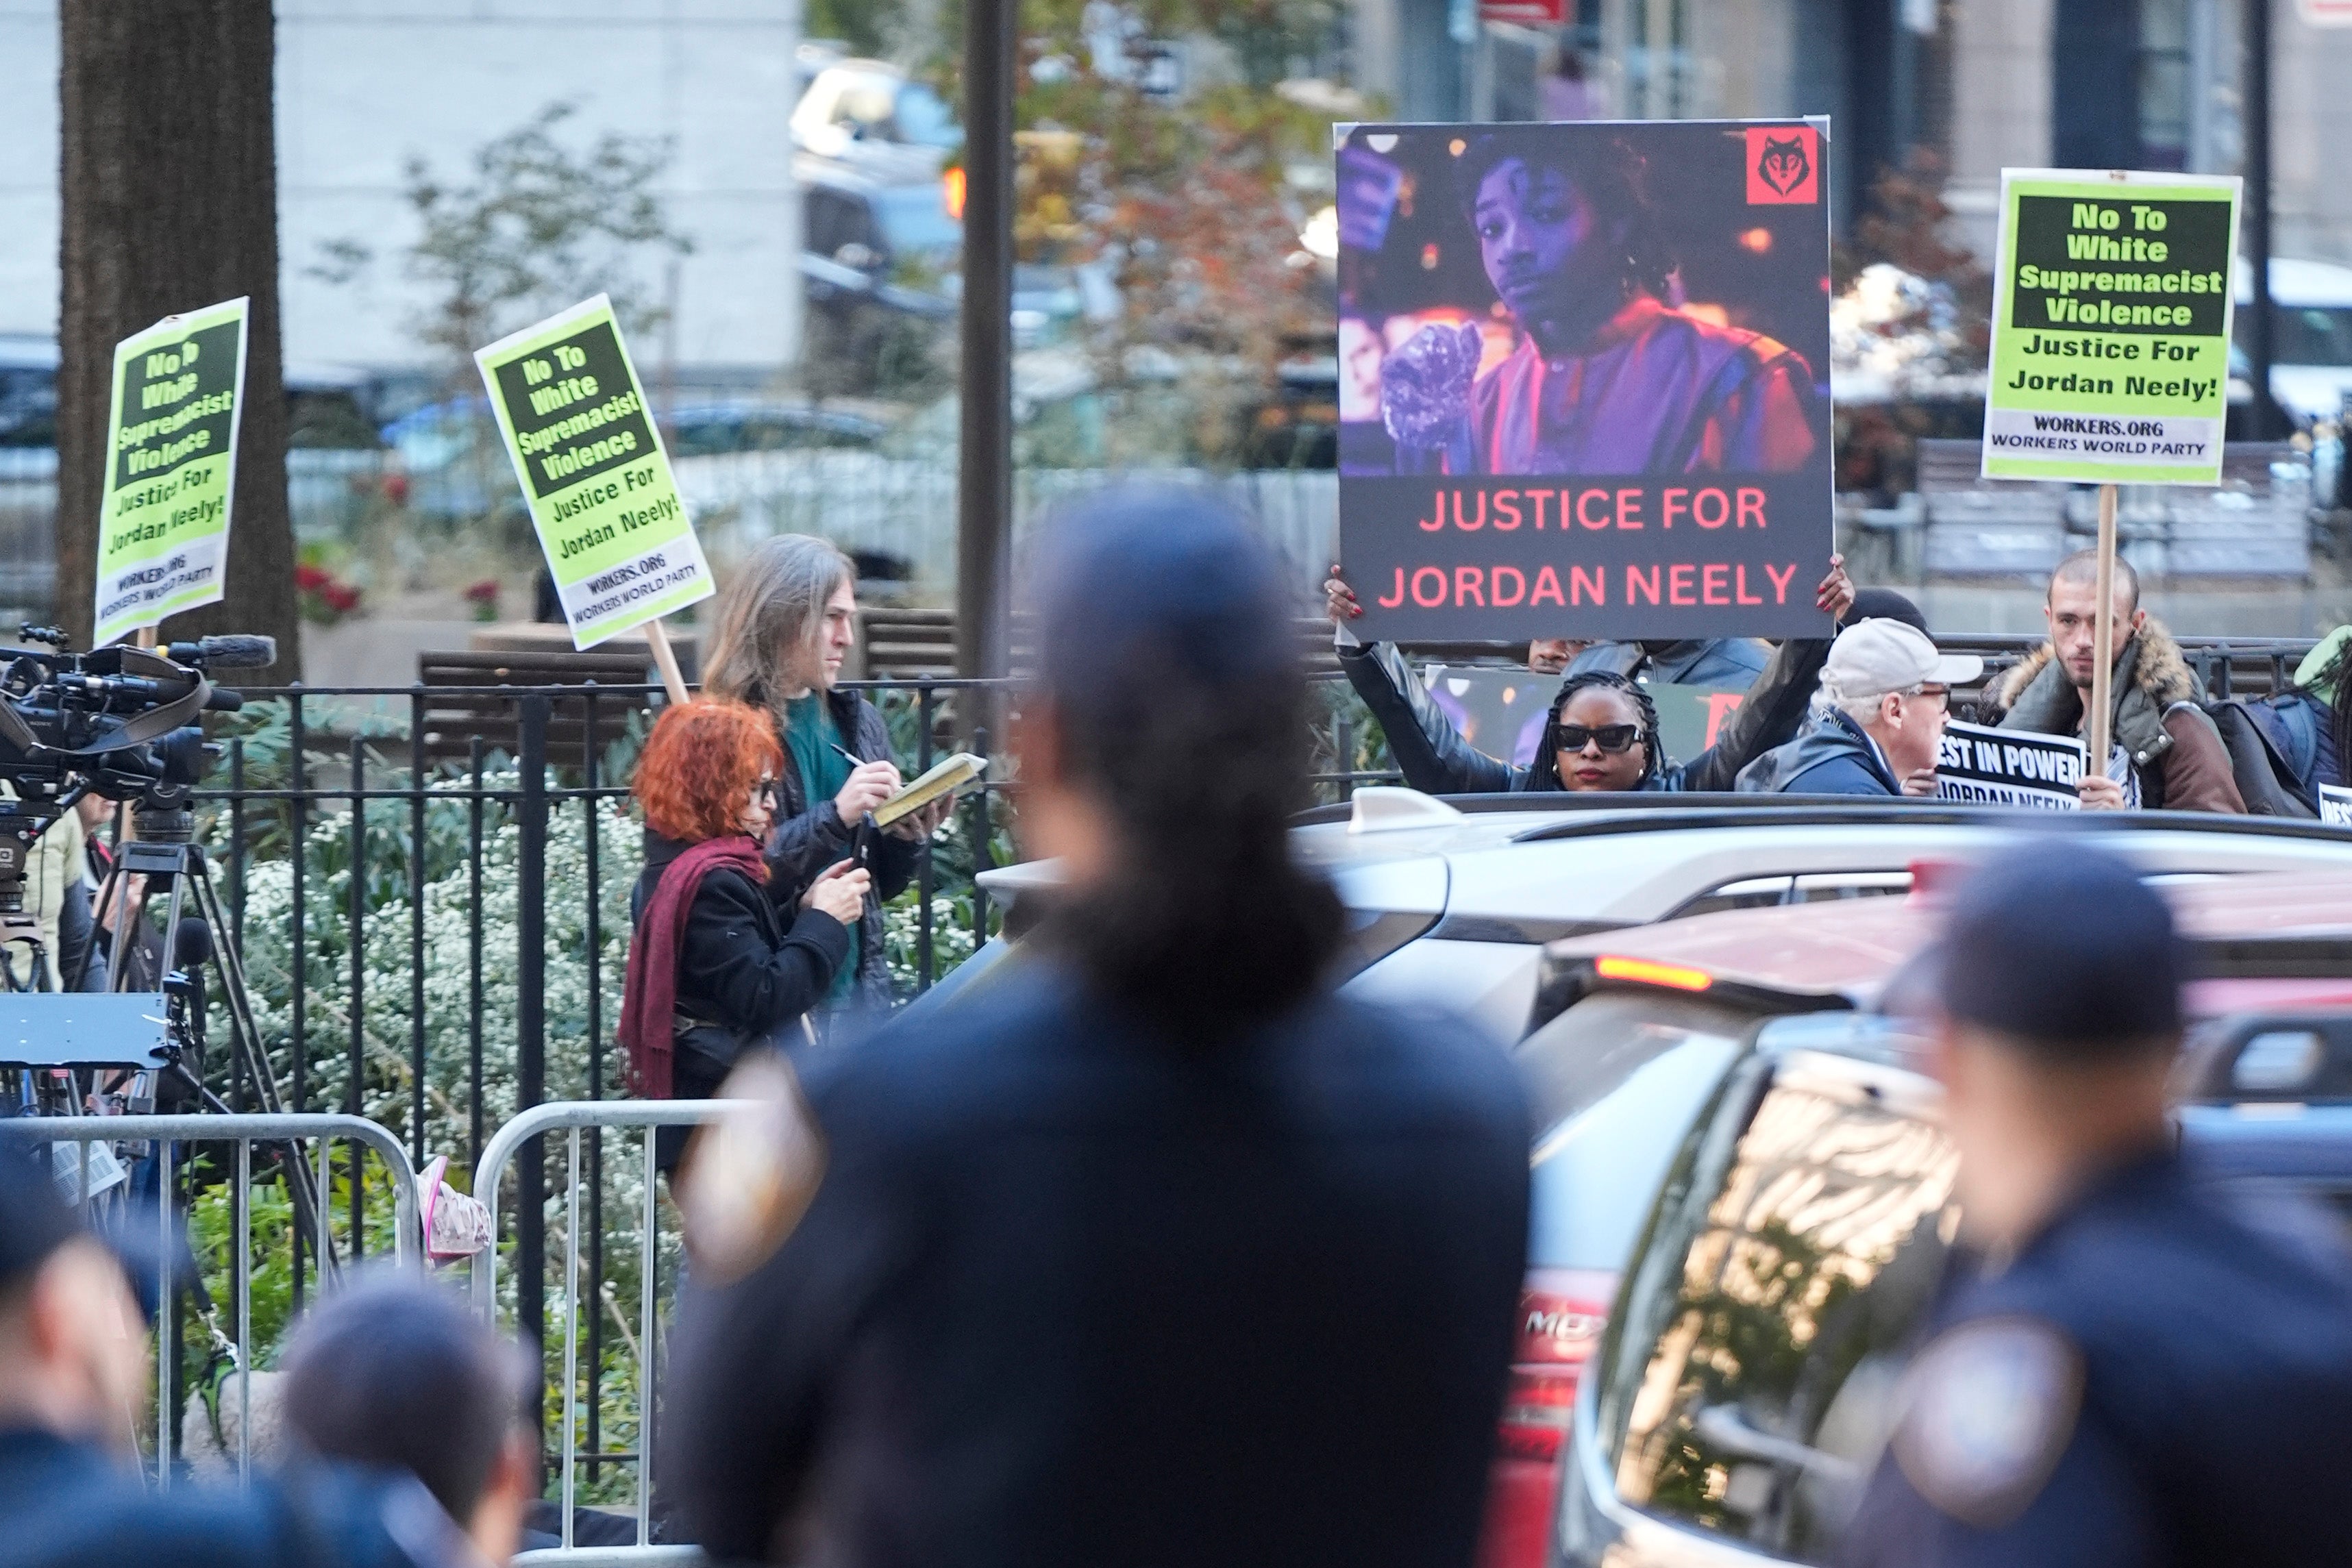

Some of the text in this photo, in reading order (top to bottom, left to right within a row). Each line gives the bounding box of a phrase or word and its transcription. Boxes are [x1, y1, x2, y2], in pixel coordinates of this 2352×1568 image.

[2072, 203, 2167, 231] No To
[2067, 234, 2168, 262] White
[2019, 264, 2223, 295] Supremacist
[2046, 297, 2192, 326] Violence
[2023, 334, 2200, 360] Justice For
[145, 353, 180, 379] No
[522, 345, 586, 386] No To
[529, 375, 599, 416] White
[2009, 371, 2217, 401] Jordan Neely!
[518, 390, 641, 455] Supremacist
[2033, 415, 2164, 436] WORKERS.ORG
[541, 431, 637, 480] Violence
[1992, 434, 2205, 456] WORKERS WORLD PARTY
[183, 468, 212, 490] For
[554, 467, 654, 522] Justice For
[1419, 487, 1766, 531] JUSTICE FOR
[109, 522, 166, 554] Jordan
[561, 493, 679, 559] Jordan Neely!
[586, 553, 666, 595] WORKERS.ORG
[1378, 564, 1796, 608] JORDAN NEELY
[573, 564, 696, 623] WORKERS WORLD PARTY
[1937, 734, 2080, 786] EST IN POWER
[2323, 799, 2352, 827] RES
